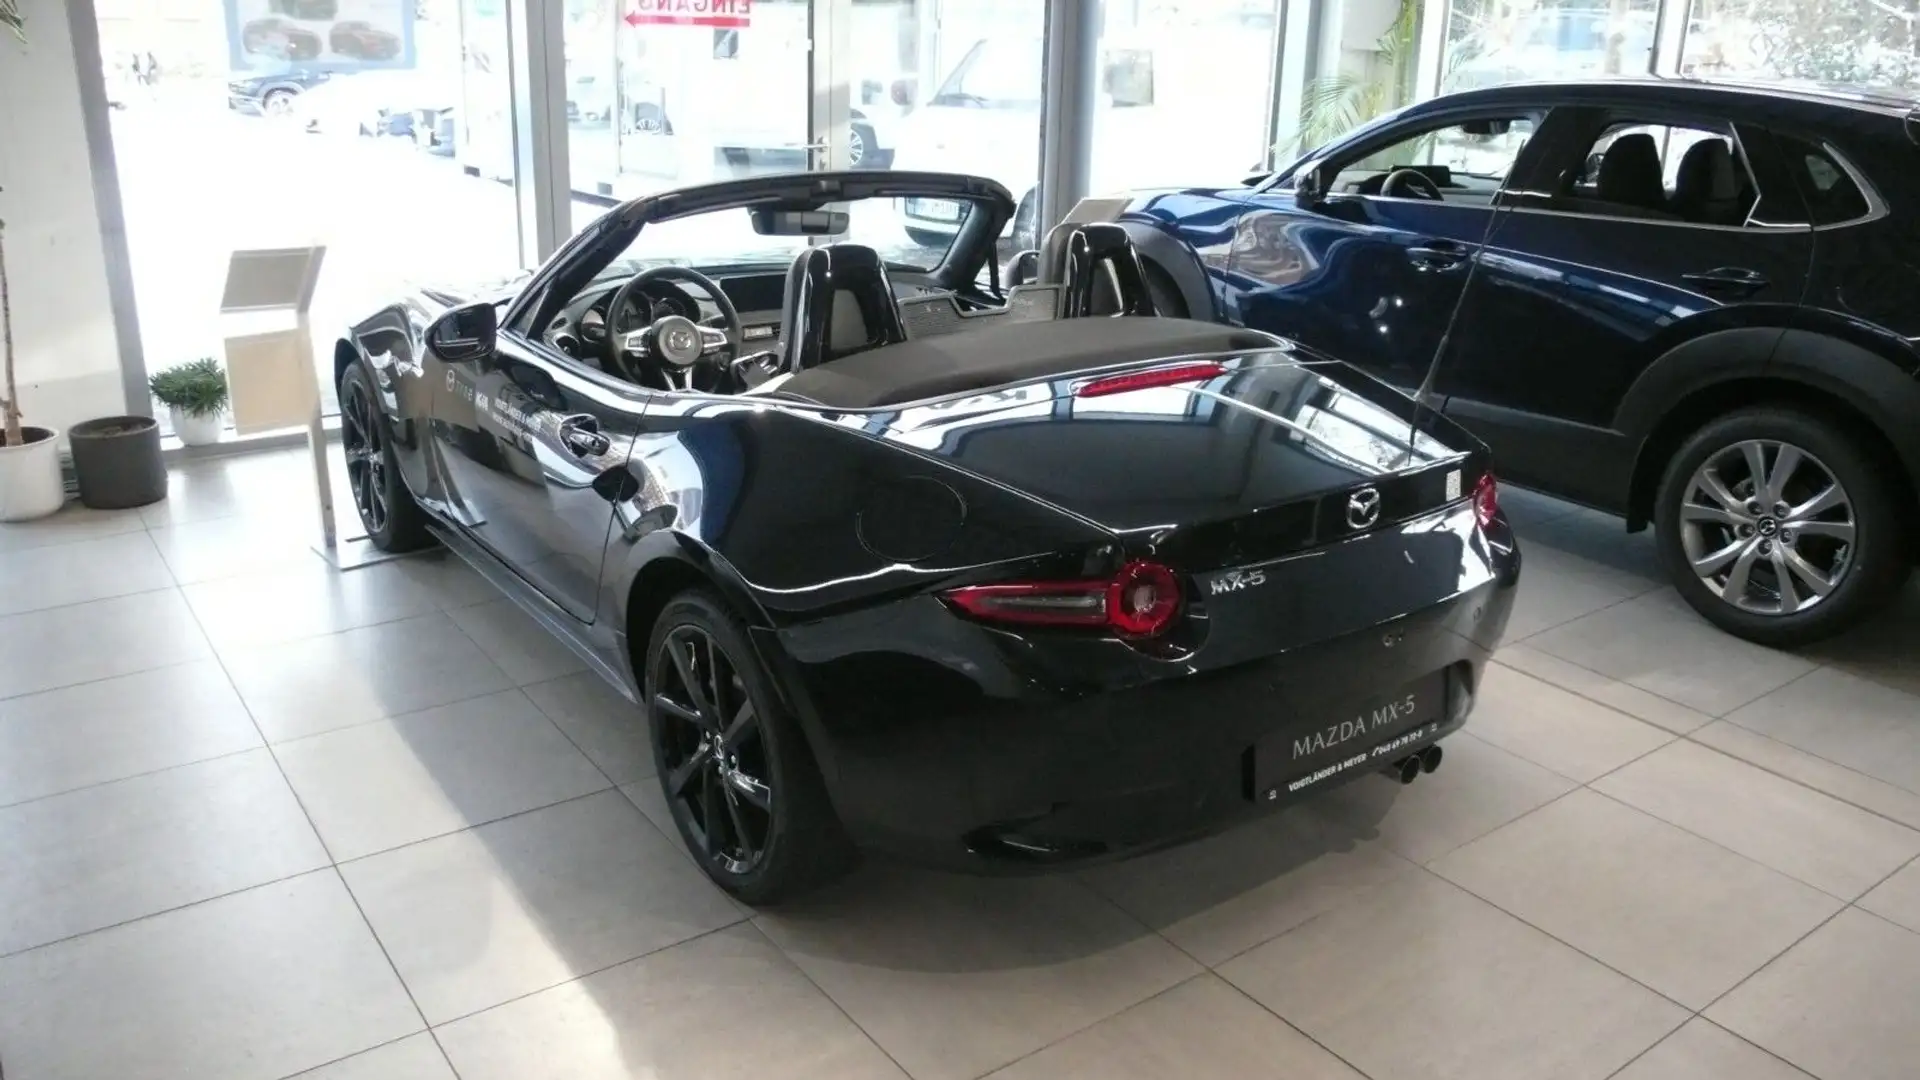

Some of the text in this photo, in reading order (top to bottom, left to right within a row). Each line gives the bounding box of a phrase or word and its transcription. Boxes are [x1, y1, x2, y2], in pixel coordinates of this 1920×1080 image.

[1209, 569, 1266, 595] MX-5
[1292, 694, 1415, 760] MAZDA MX-5
